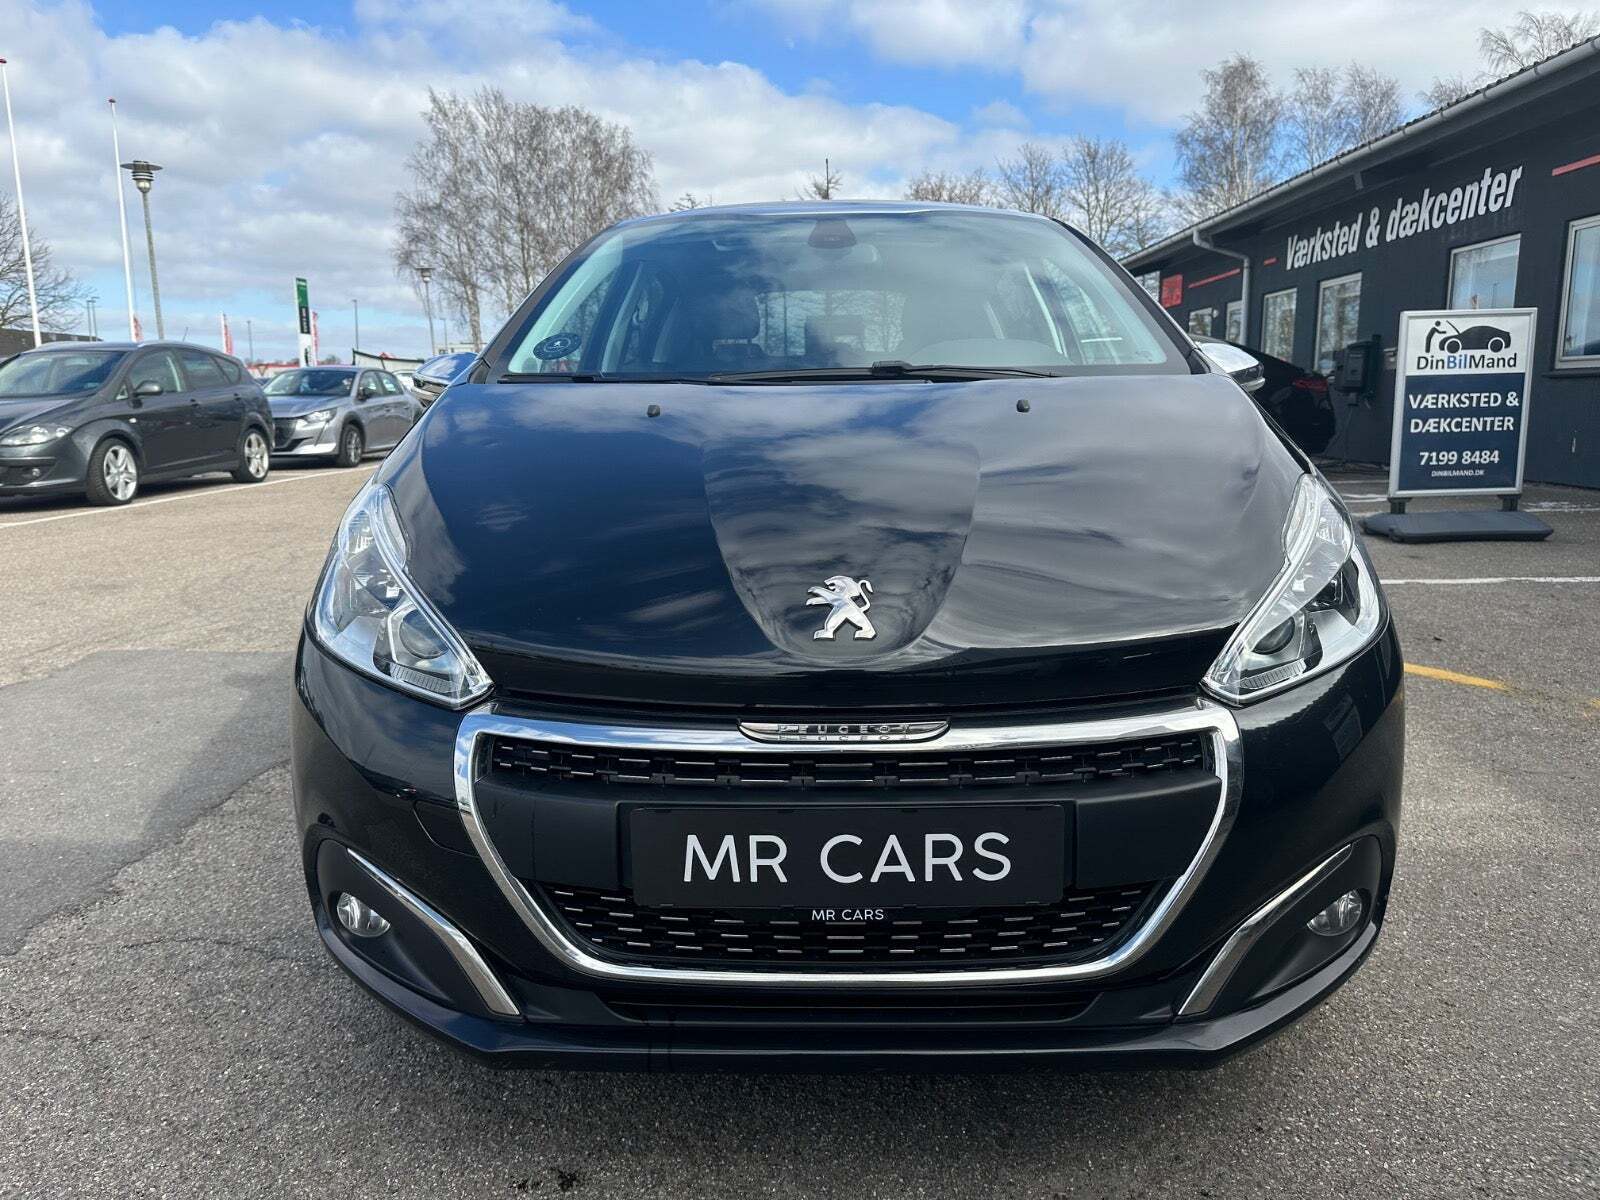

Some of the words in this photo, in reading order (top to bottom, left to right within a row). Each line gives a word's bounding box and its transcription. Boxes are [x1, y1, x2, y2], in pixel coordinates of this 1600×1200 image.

[1286, 213, 1363, 271] Værksted
[1365, 207, 1381, 249] &
[1385, 165, 1523, 243] dækcenter
[1416, 353, 1517, 370] DinBilMand
[1409, 392, 1501, 409] VÆRKSTED
[1506, 391, 1519, 407] &
[1410, 416, 1514, 433] DÆKCENTER
[1419, 451, 1457, 466] 7199
[1461, 450, 1500, 464] 8484
[778, 724, 911, 735] PEUGEOT
[683, 834, 788, 883] MR
[820, 832, 1011, 884] CARS
[811, 909, 836, 921] MR
[841, 909, 884, 921] CARS
